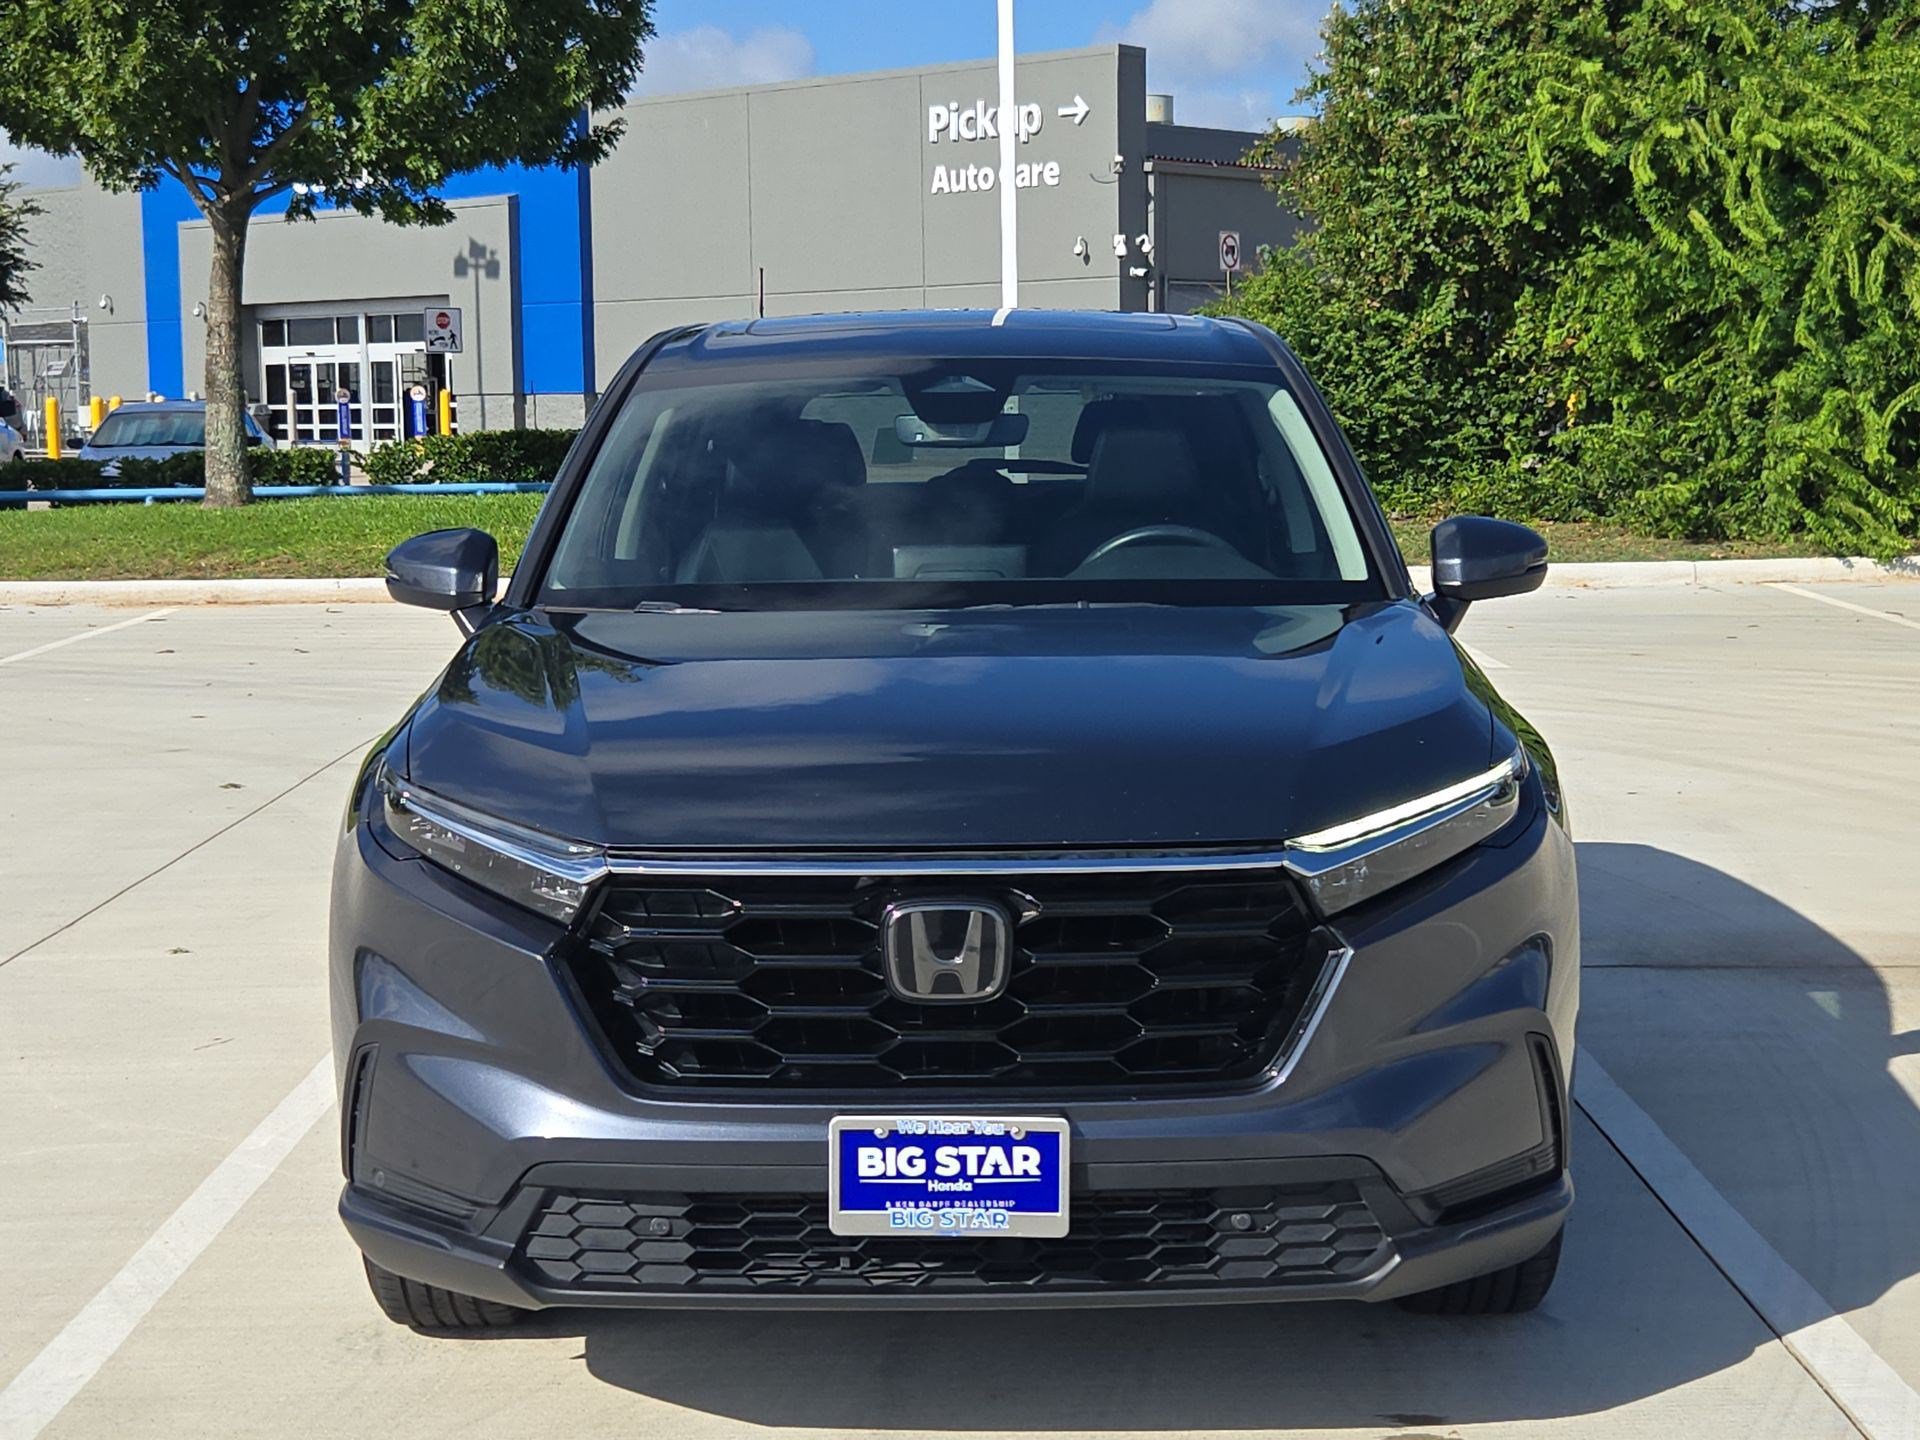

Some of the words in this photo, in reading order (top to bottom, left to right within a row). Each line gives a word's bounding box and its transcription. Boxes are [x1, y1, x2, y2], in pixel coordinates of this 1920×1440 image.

[931, 163, 995, 194] Auto
[999, 160, 1060, 189] are
[896, 1119, 926, 1135] We
[928, 1119, 970, 1135] Hear
[972, 1119, 1005, 1136] You
[857, 1146, 926, 1177] BIG
[935, 1146, 1041, 1177] STAR
[927, 1179, 973, 1192] Honda
[890, 1208, 934, 1228] BIG
[940, 1208, 1010, 1229] STAR
